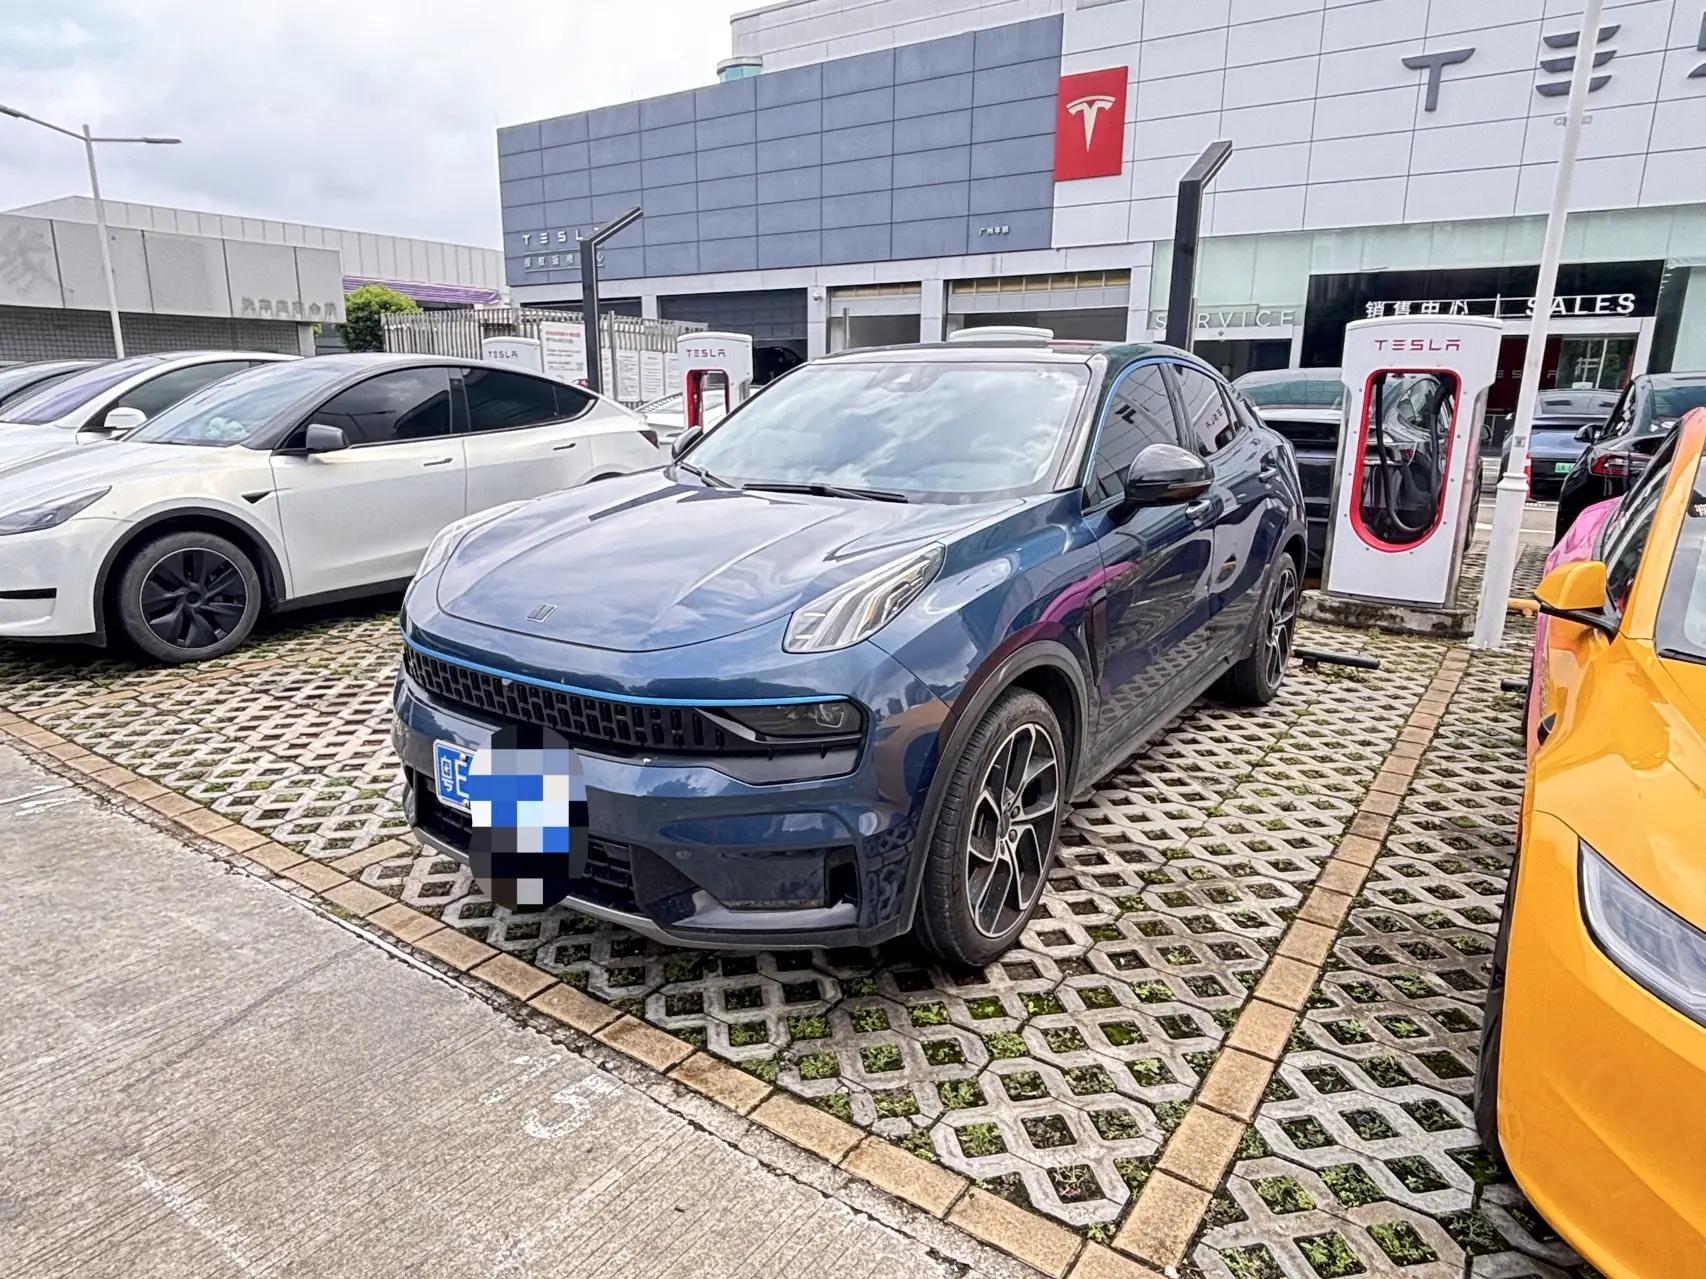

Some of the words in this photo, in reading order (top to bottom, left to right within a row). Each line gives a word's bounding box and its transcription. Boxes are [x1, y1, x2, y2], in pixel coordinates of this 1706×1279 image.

[1401, 11, 1706, 112] TE
[522, 226, 600, 246] TESL
[1365, 300, 1469, 319] 销售中心
[1154, 309, 1294, 331] SRVICE
[686, 348, 726, 359] TESLA
[1374, 339, 1462, 351] TESLA
[487, 350, 518, 360] TESLA
